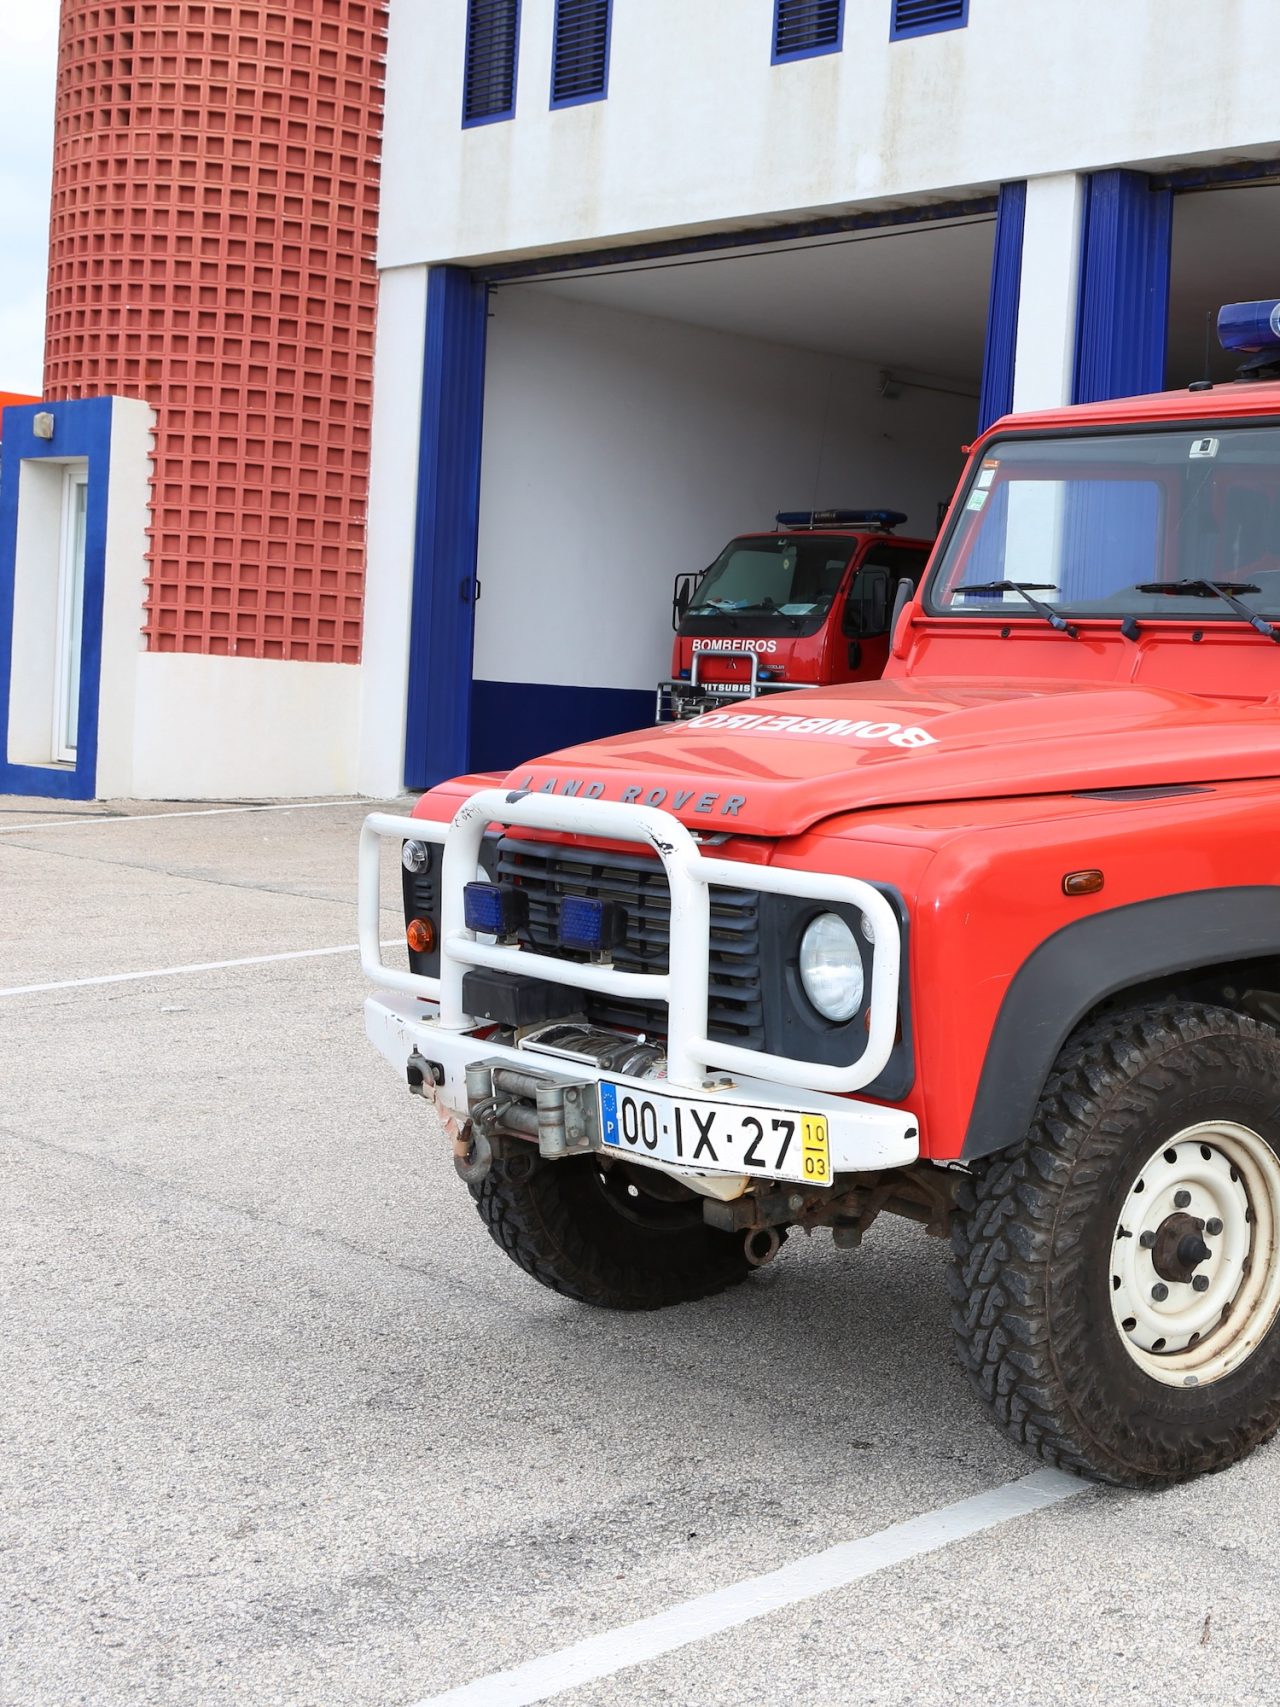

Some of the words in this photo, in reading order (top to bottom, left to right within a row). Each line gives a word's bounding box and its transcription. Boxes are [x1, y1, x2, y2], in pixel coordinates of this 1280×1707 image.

[692, 639, 777, 653] BOMBEIROS
[519, 775, 605, 800] LAND
[620, 783, 747, 816] ROVER
[606, 1121, 614, 1134] P
[805, 1124, 825, 1142] 10
[805, 1157, 826, 1175] 03
